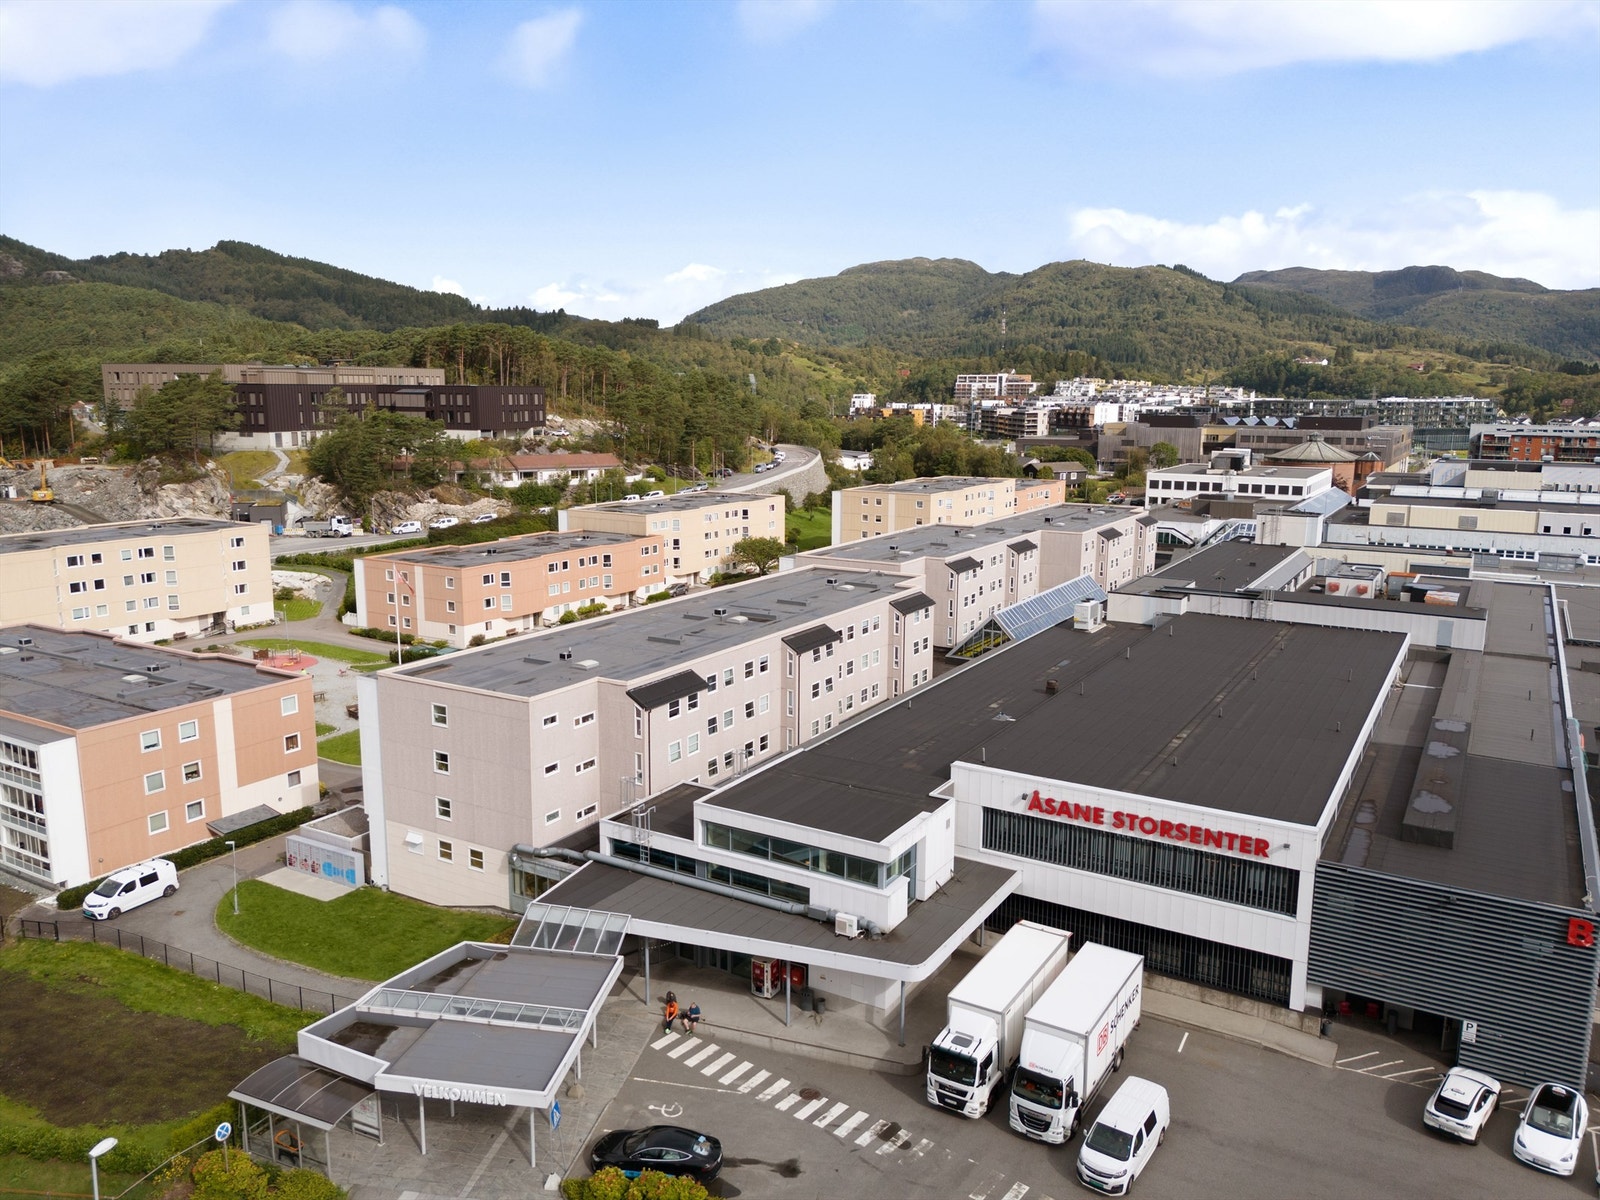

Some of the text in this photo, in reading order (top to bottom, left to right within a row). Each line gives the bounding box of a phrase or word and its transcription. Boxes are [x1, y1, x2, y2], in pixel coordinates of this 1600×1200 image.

[1028, 790, 1269, 857] ÅSANE STORSENTER
[1567, 917, 1594, 947] B
[1110, 984, 1139, 1033] SCHENKER
[1466, 1022, 1474, 1031] P
[413, 1083, 506, 1106] VELKOMMEN
